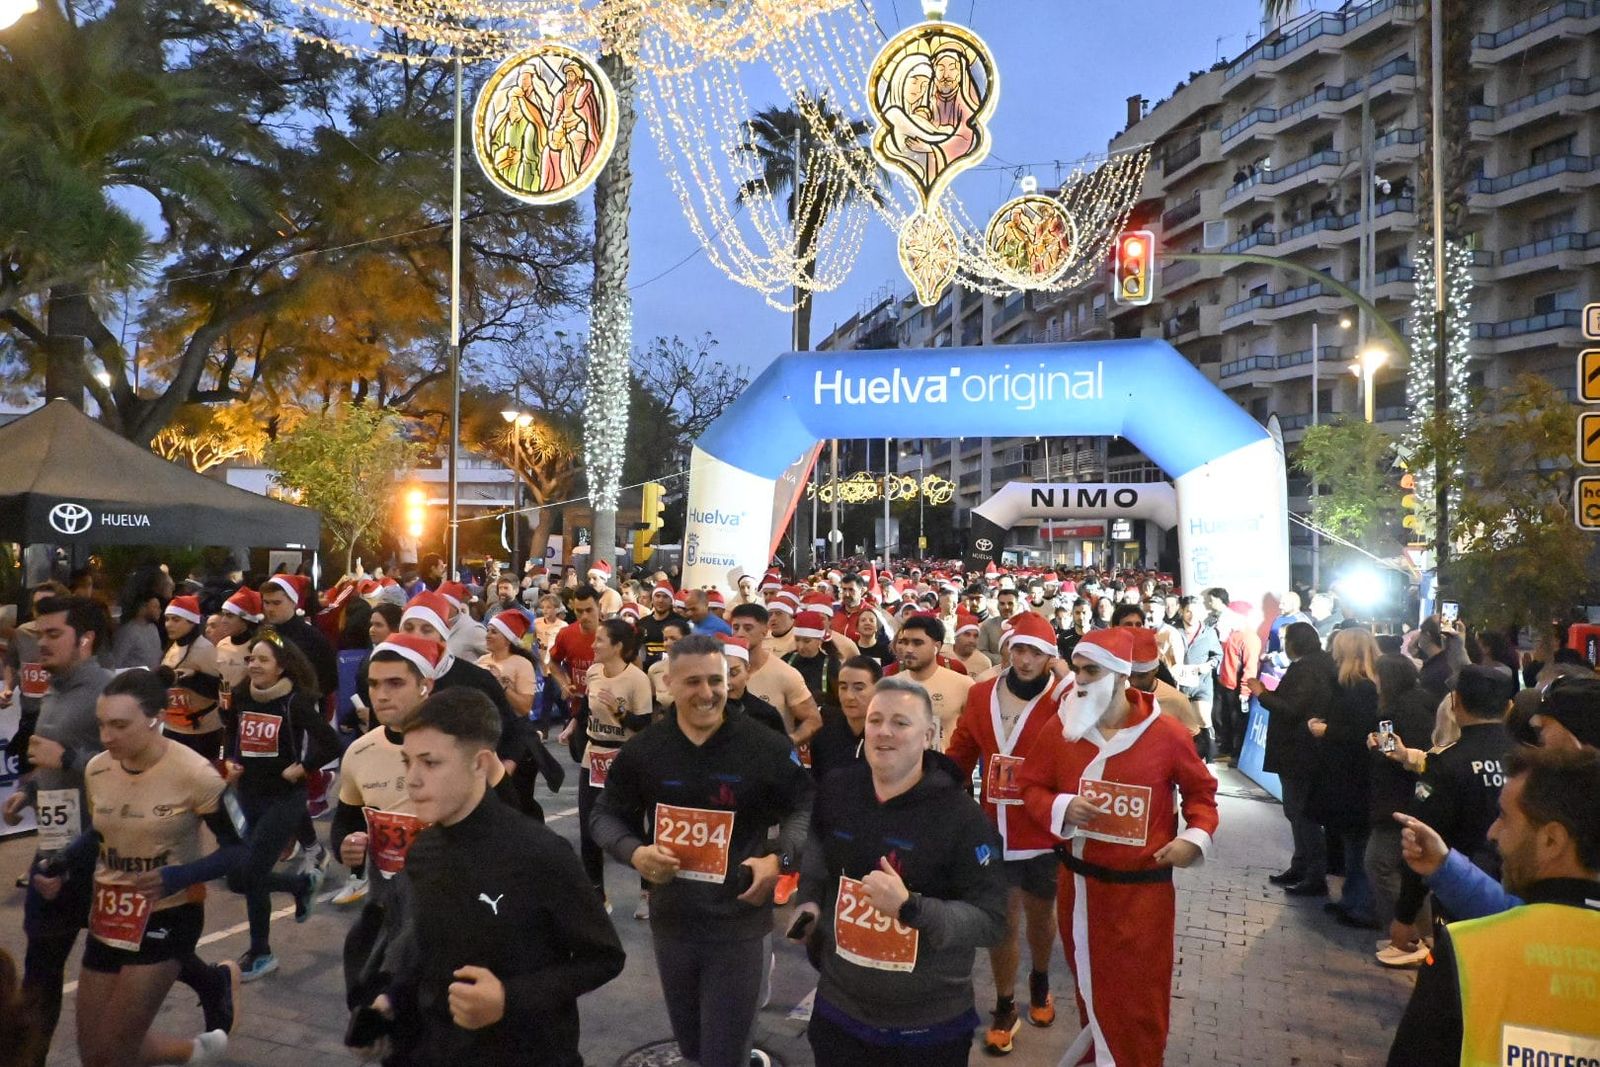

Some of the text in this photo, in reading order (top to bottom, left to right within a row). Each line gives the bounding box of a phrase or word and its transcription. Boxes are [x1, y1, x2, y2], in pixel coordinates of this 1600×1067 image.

[814, 360, 1103, 410] Huelva original
[1031, 488, 1138, 508] NIMO
[101, 513, 150, 527] HUELVA
[689, 507, 740, 526] Huelva
[700, 556, 736, 567] HUELVA
[241, 720, 276, 739] 1510
[1483, 774, 1507, 787] LO
[658, 817, 727, 849] 2294
[97, 888, 147, 917] 1357
